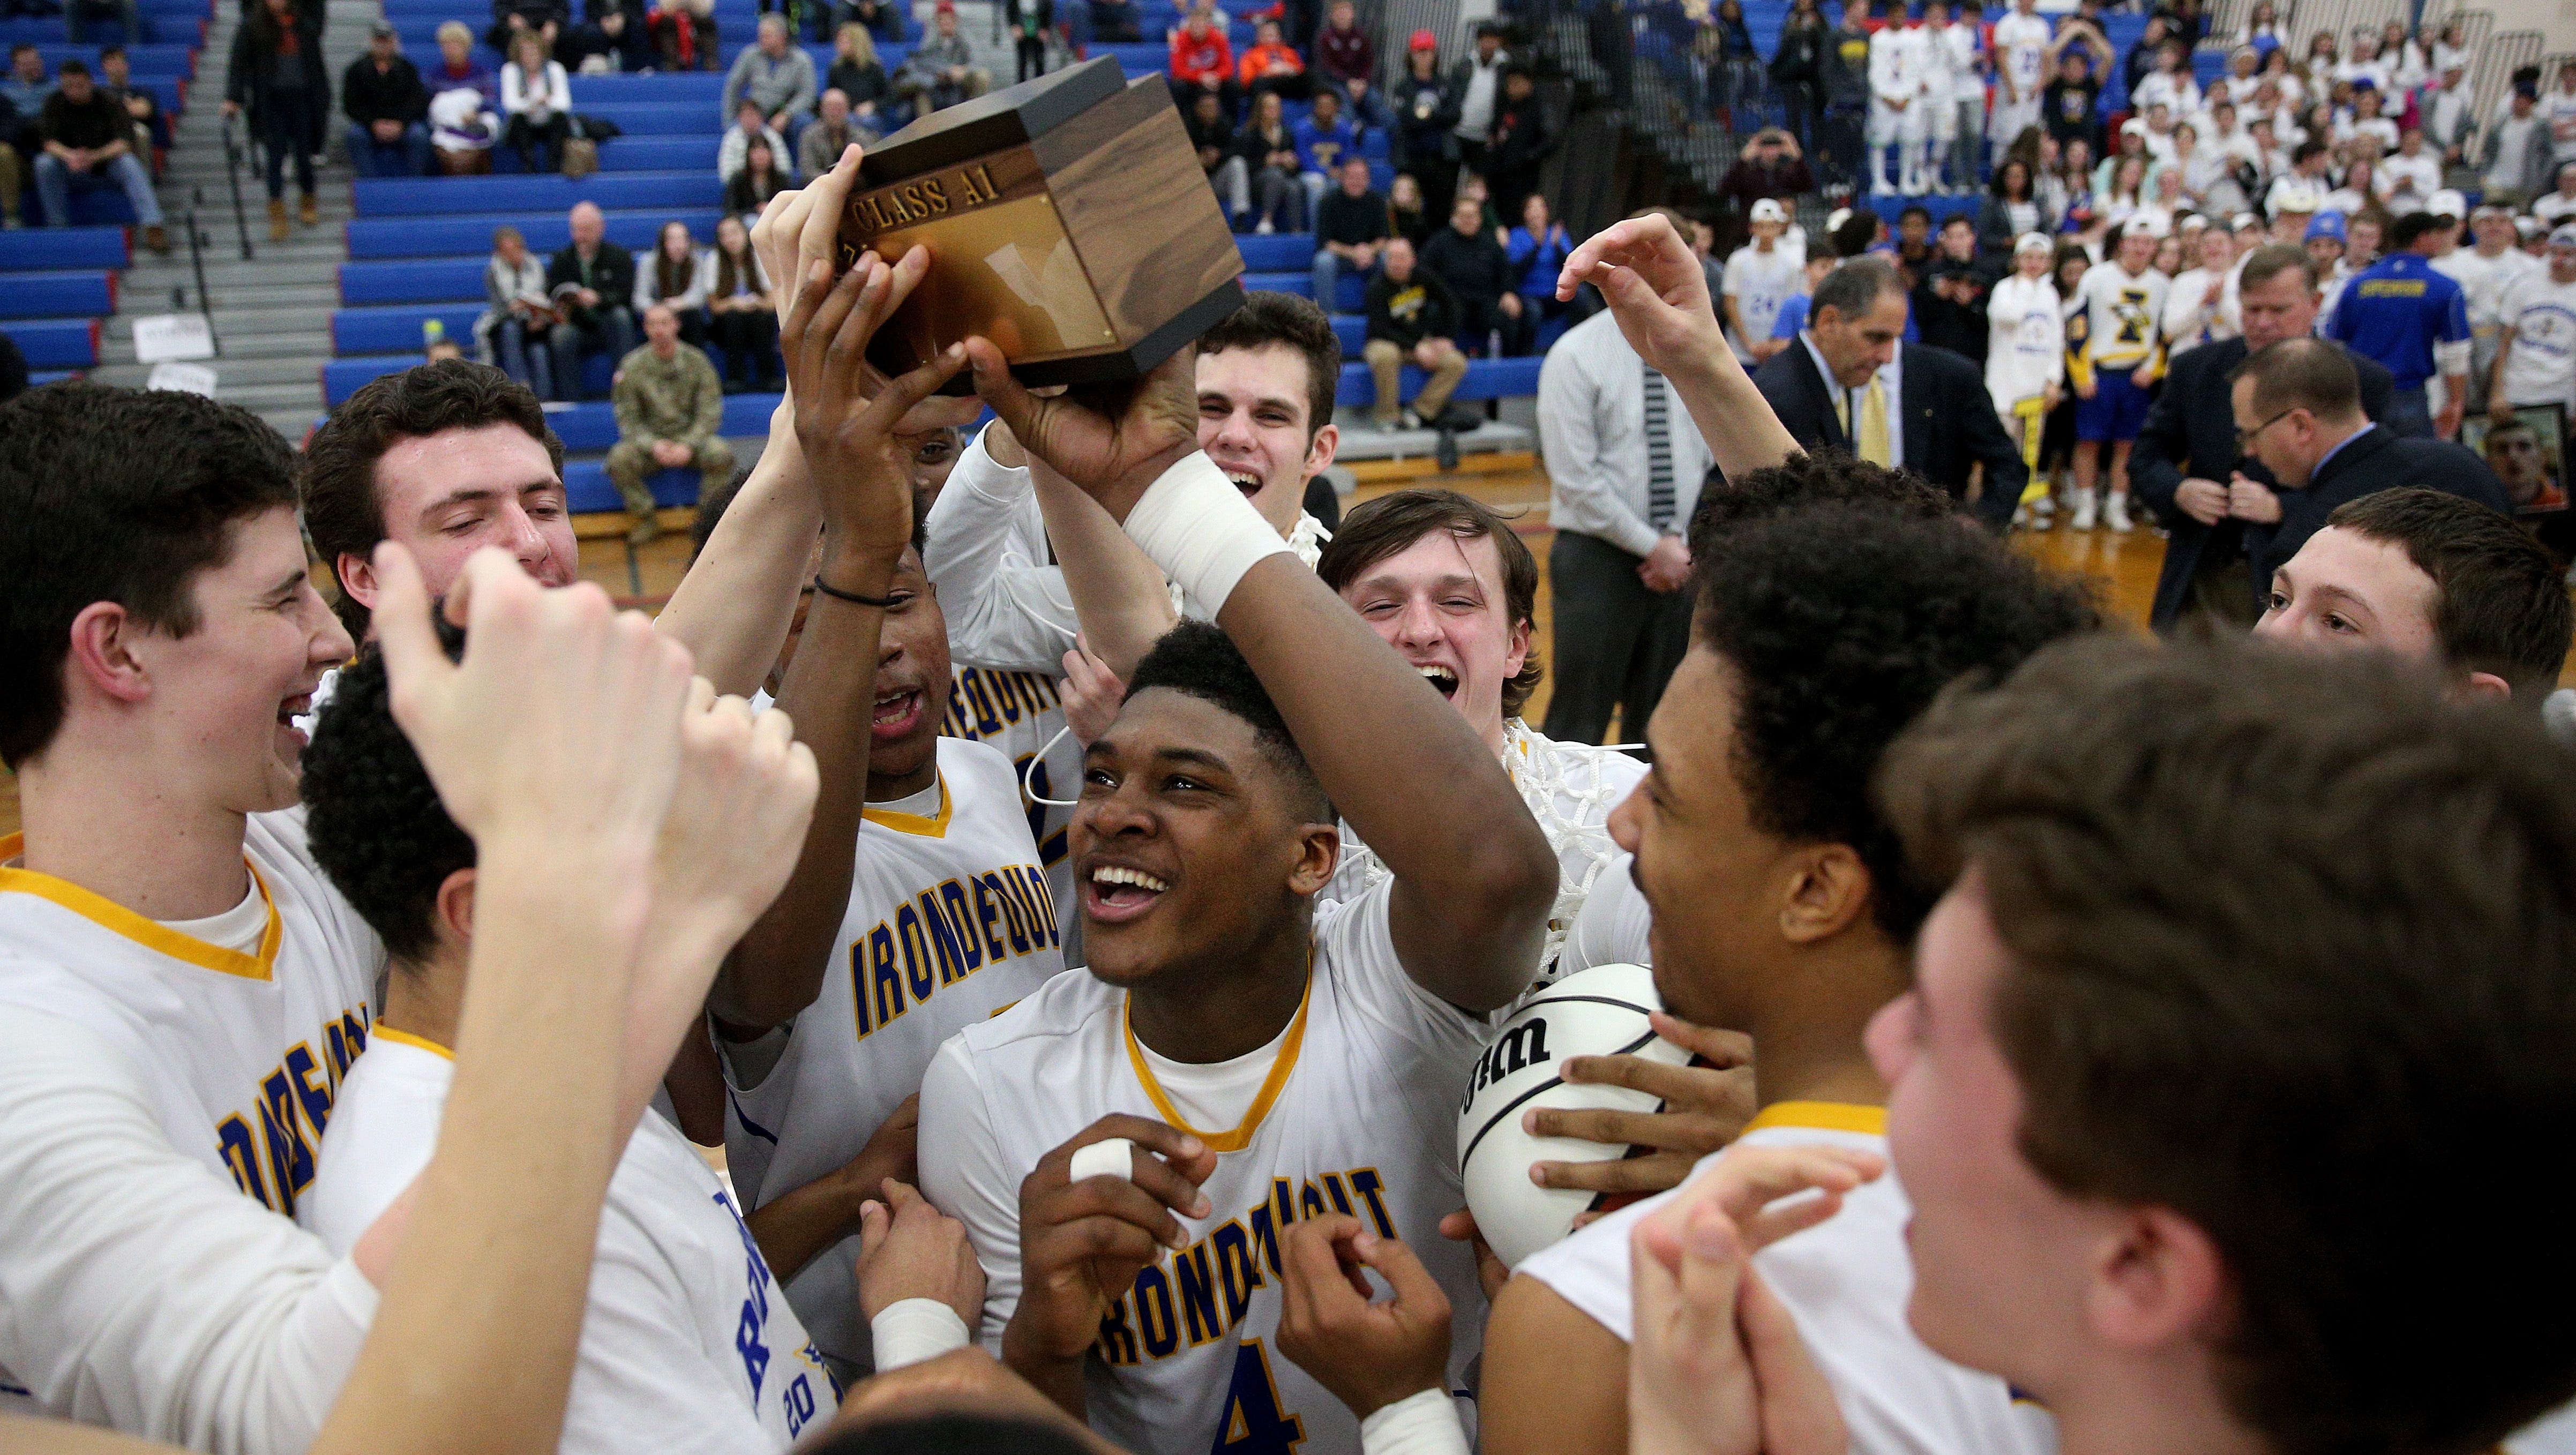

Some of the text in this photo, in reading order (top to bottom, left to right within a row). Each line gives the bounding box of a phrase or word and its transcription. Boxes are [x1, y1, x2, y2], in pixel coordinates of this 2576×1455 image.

[853, 164, 999, 232] CLASS A1
[1210, 1337, 1308, 1455] 4
